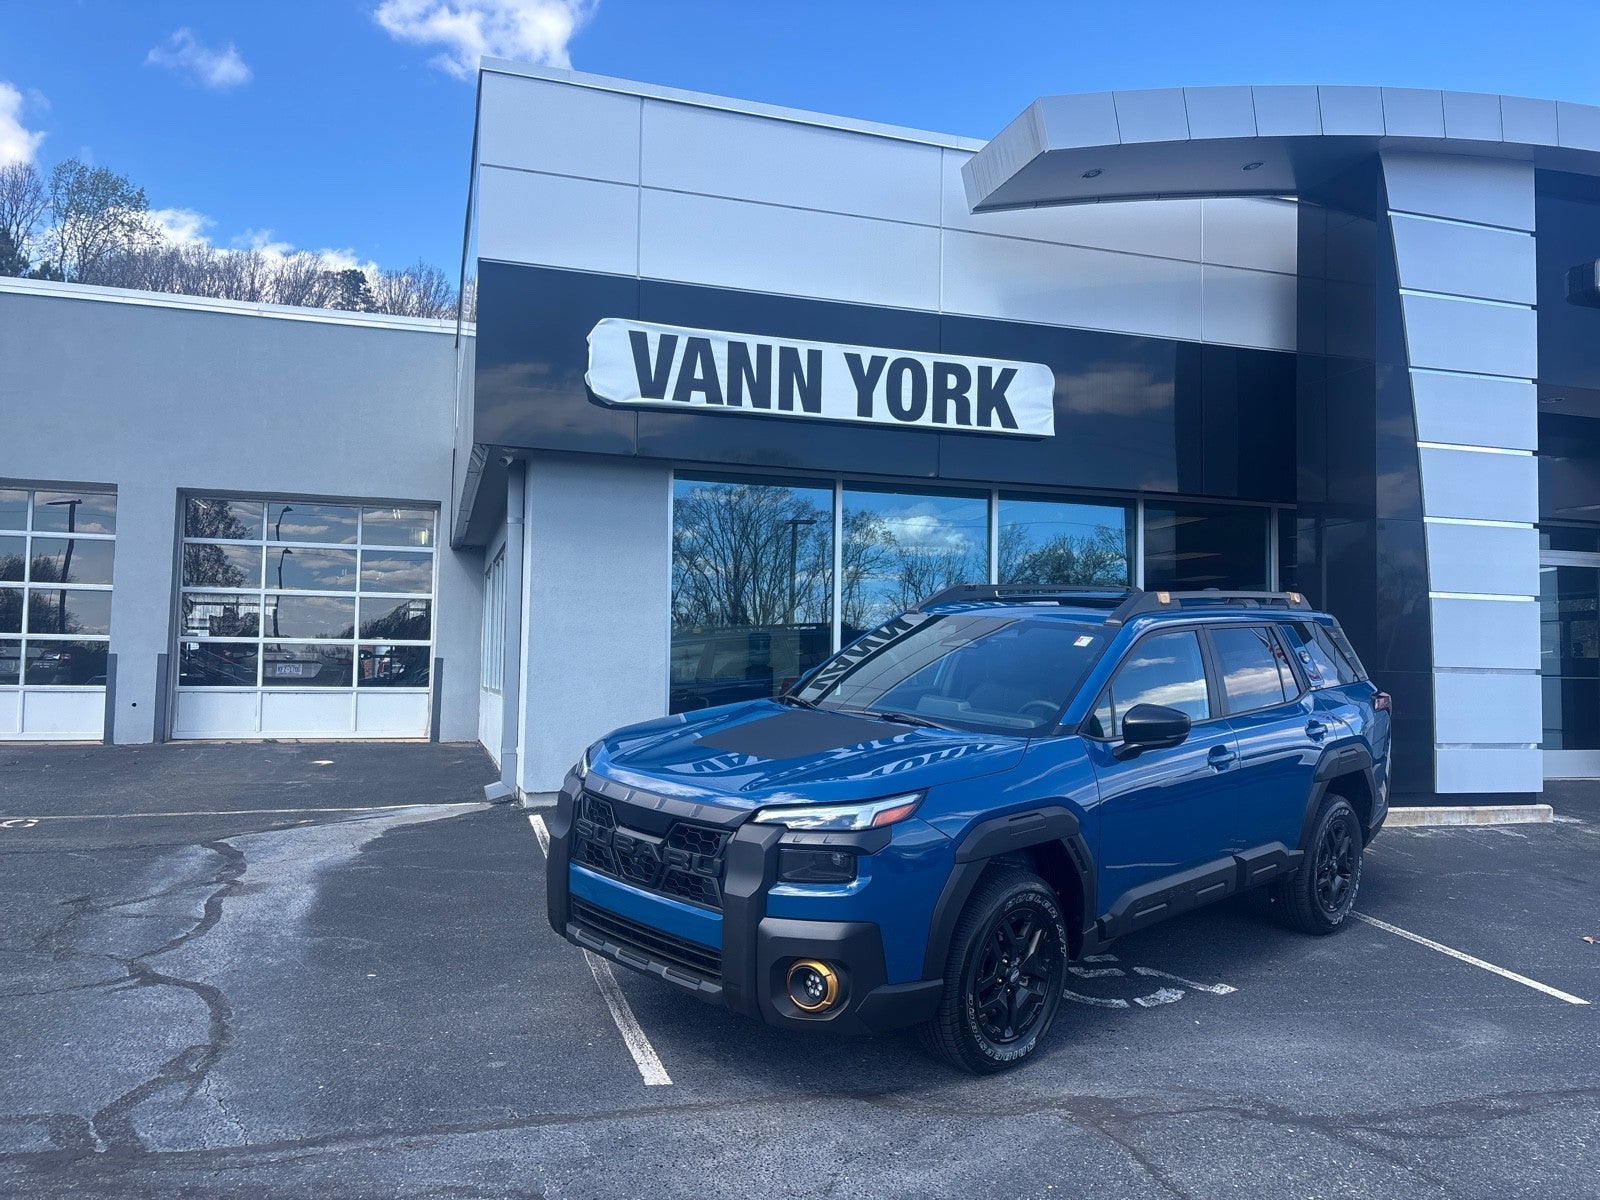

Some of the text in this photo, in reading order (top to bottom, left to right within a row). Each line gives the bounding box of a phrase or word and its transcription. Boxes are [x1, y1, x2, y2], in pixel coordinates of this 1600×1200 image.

[628, 330, 1019, 430] VANN YORK
[575, 818, 726, 878] SUBARU
[1056, 924, 1067, 958] A/T
